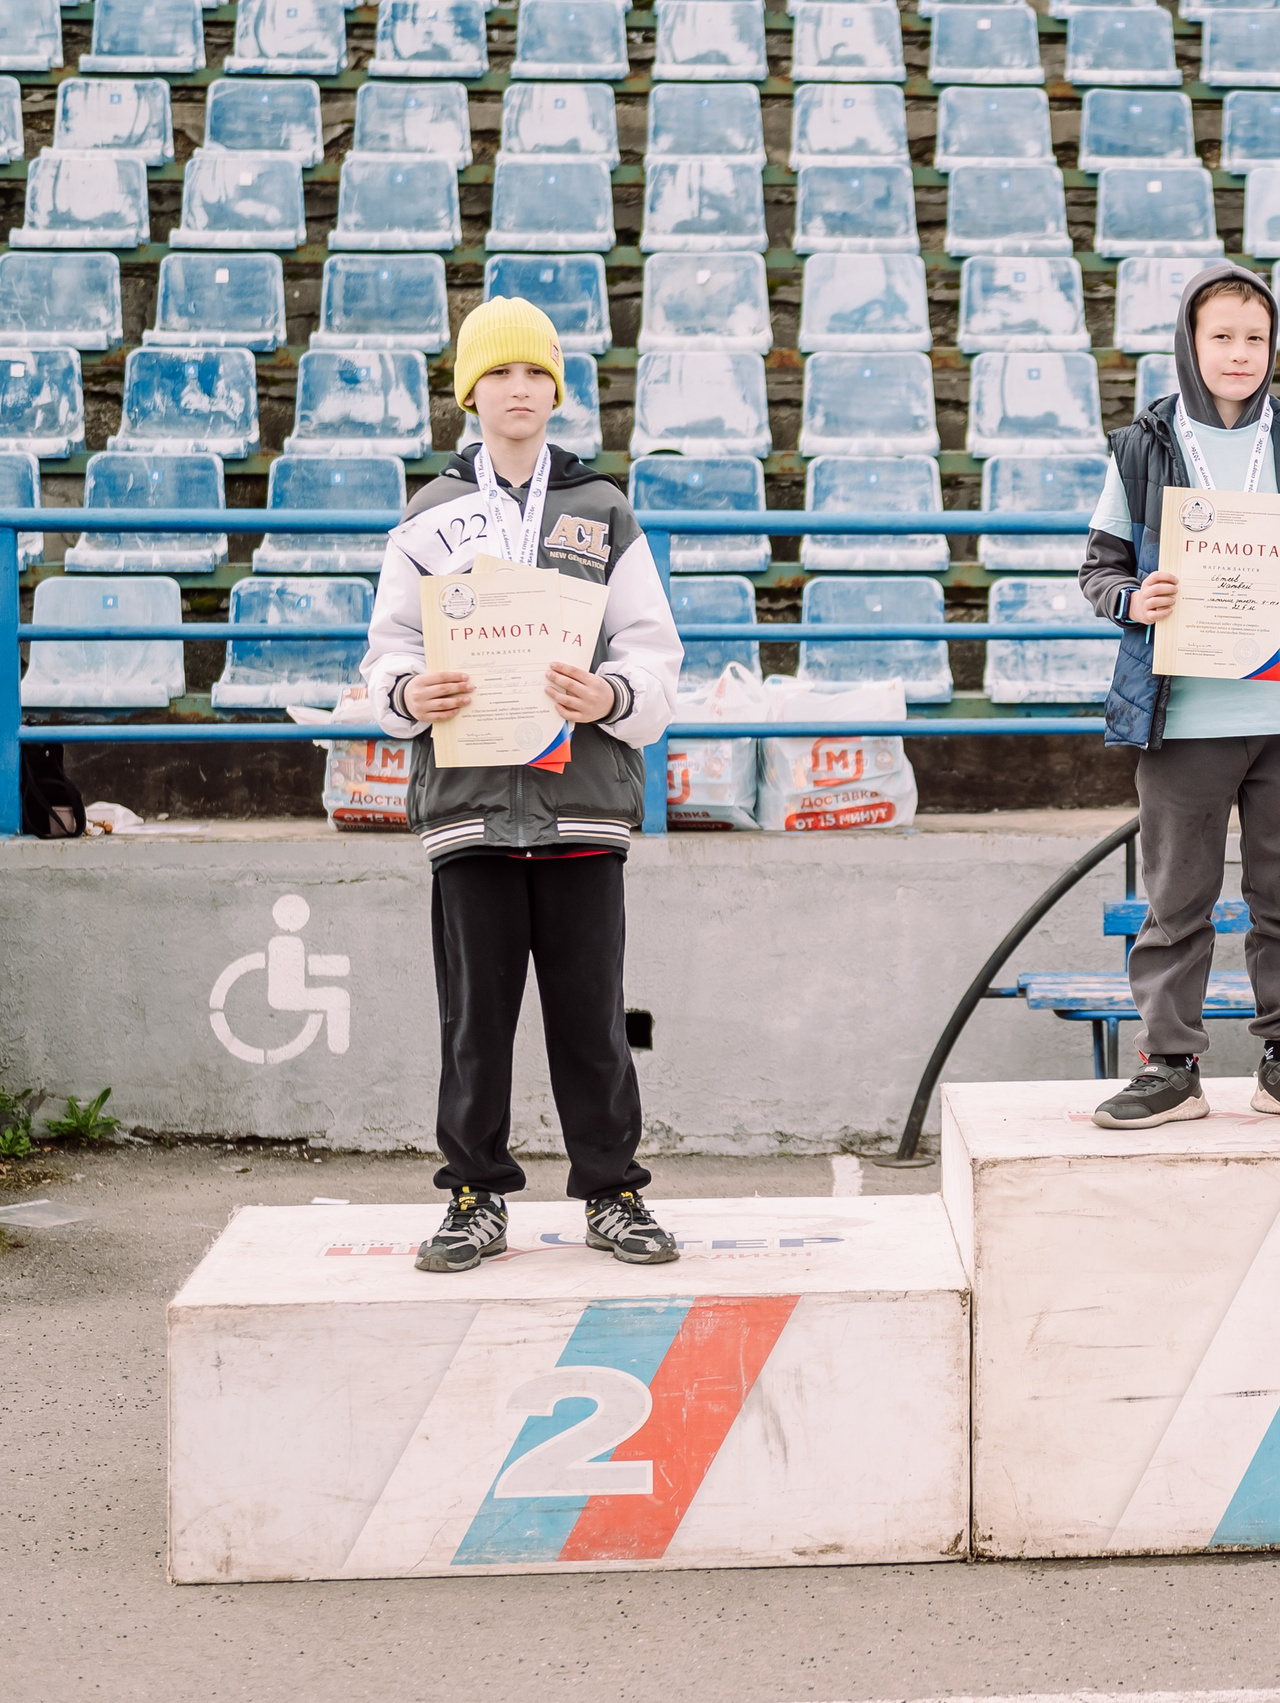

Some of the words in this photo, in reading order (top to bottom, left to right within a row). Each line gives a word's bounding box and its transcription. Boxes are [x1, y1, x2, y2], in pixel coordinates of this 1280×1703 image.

[434, 513, 488, 557] 122
[545, 514, 611, 562] ACL
[1185, 540, 1279, 558] ГРАМОТА
[550, 551, 567, 560] NEW
[567, 553, 606, 571] GENERATION
[1202, 565, 1260, 573] НАГРАЖДАЕТСЯ
[450, 623, 549, 641] ГРАМОТА
[471, 649, 532, 657] НАГРАЖДАЕТСЯ
[801, 789, 879, 809] Доставка
[795, 817, 814, 830] от
[818, 812, 836, 827] 15
[839, 807, 888, 826] минут
[687, 1251, 812, 1261] АДИОН
[493, 1365, 654, 1499] 2
